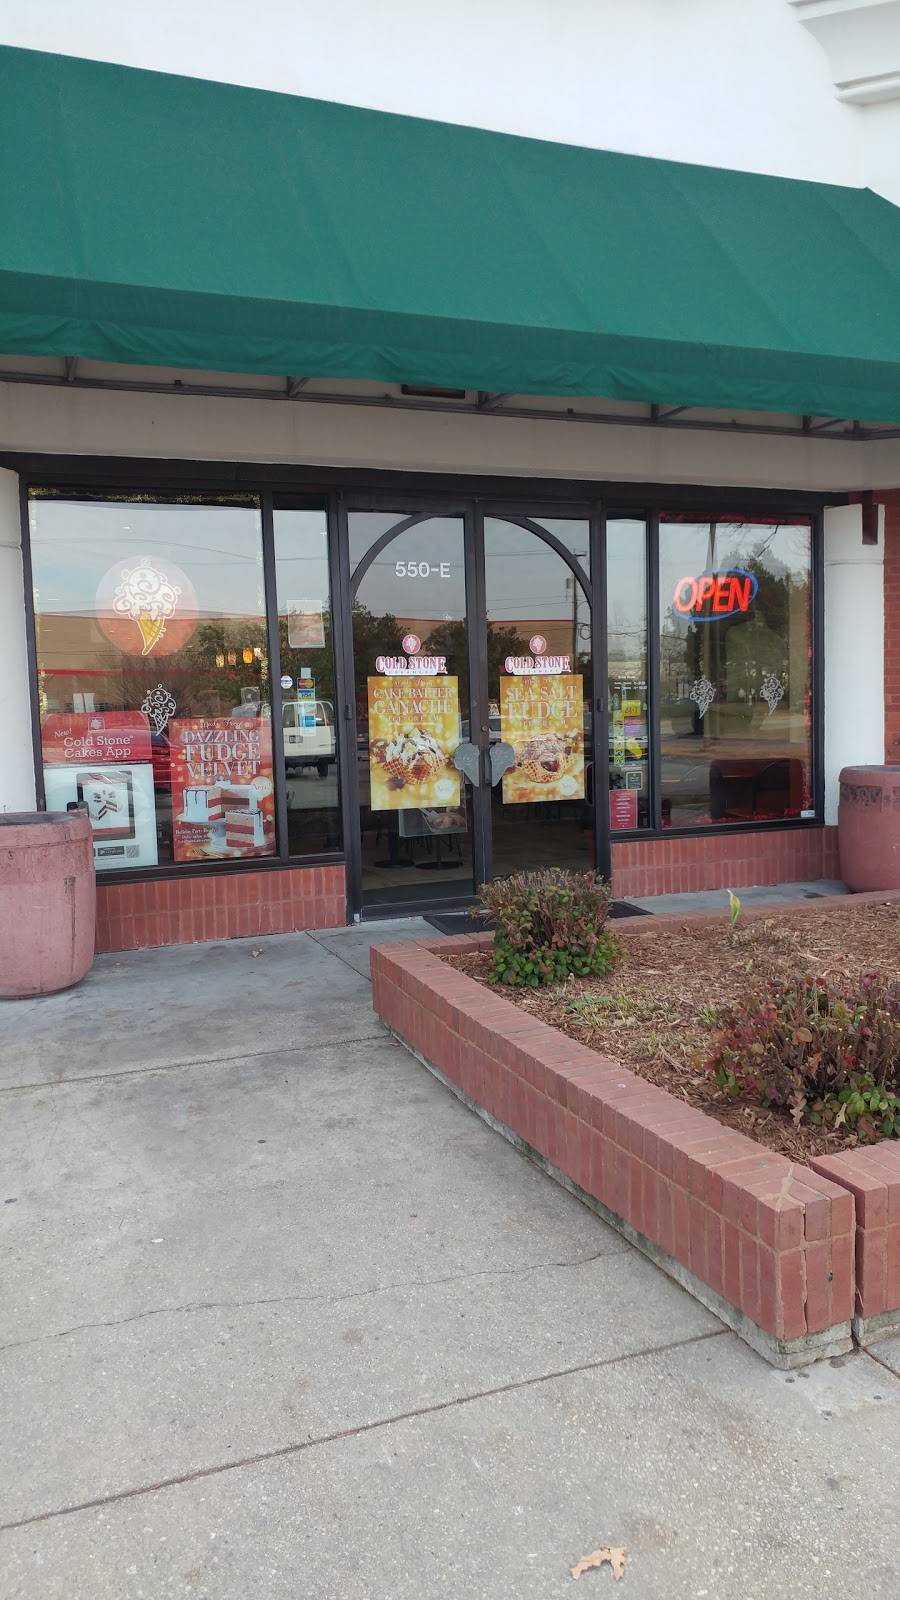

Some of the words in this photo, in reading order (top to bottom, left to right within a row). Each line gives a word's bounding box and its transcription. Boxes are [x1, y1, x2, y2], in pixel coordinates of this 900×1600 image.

[395, 561, 451, 578] 550-E
[673, 575, 751, 612] OPEN
[375, 656, 407, 673] COLD
[408, 656, 447, 673] STONE
[505, 656, 534, 673] COLD
[535, 656, 571, 673] STONE
[507, 700, 578, 719] FUDGE
[54, 728, 72, 738] New!
[63, 736, 94, 747] Cold
[183, 729, 260, 744] DAZZLING
[63, 747, 103, 758] Cakes
[106, 746, 132, 758] App
[183, 742, 261, 762] FUDGE
[184, 760, 261, 778] VELVET
